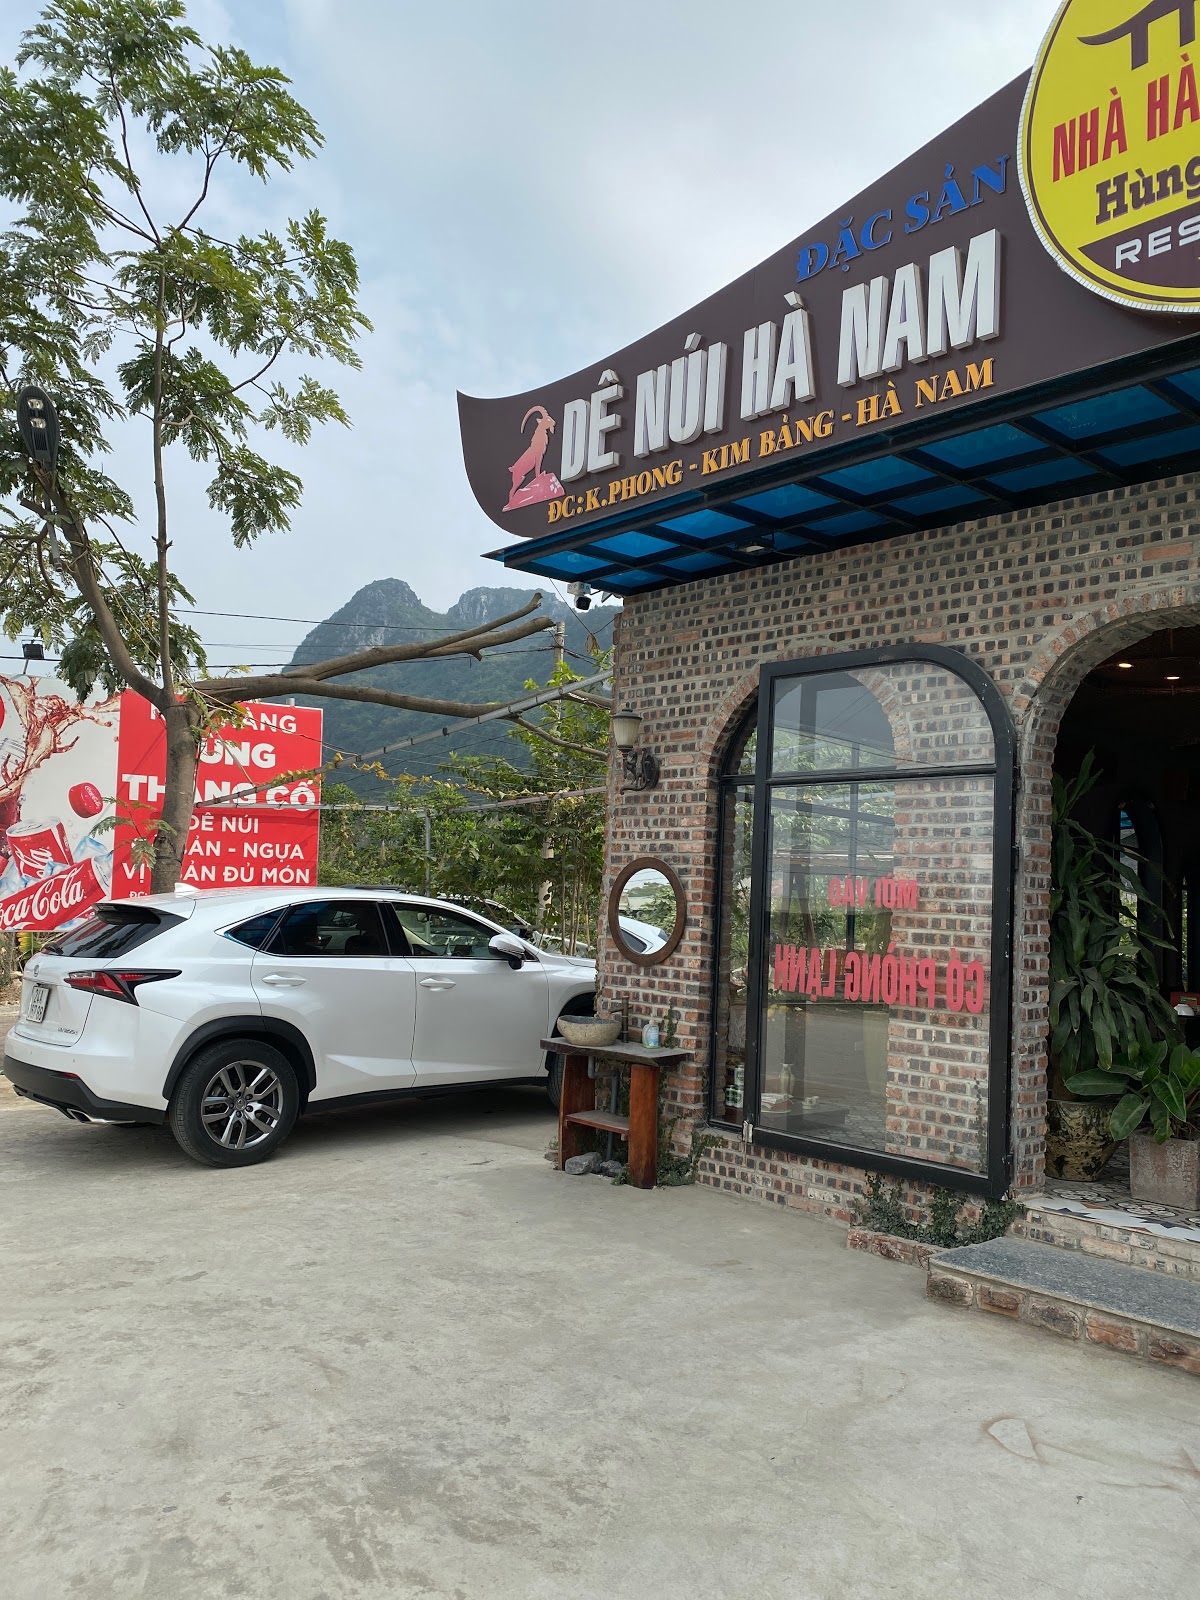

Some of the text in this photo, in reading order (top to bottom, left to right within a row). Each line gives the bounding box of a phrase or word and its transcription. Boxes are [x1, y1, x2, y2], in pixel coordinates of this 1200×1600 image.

[1052, 52, 1200, 183] NHÀ HÀ
[795, 154, 1010, 282] ĐẶC SẢN
[560, 228, 1001, 482] DÊ NÚI HÀ NAM
[701, 436, 752, 476] KIM
[758, 409, 835, 458] BẢNG
[855, 380, 904, 427] HÀ
[915, 357, 996, 408] NAM
[121, 773, 316, 812] THNG CỐ
[221, 814, 259, 834] NÚI
[180, 859, 216, 882] ẢN
[222, 861, 254, 883] ĐỦ
[261, 865, 310, 884] MÓN
[183, 835, 221, 857] ẢN
[243, 842, 305, 862] NGỰA
